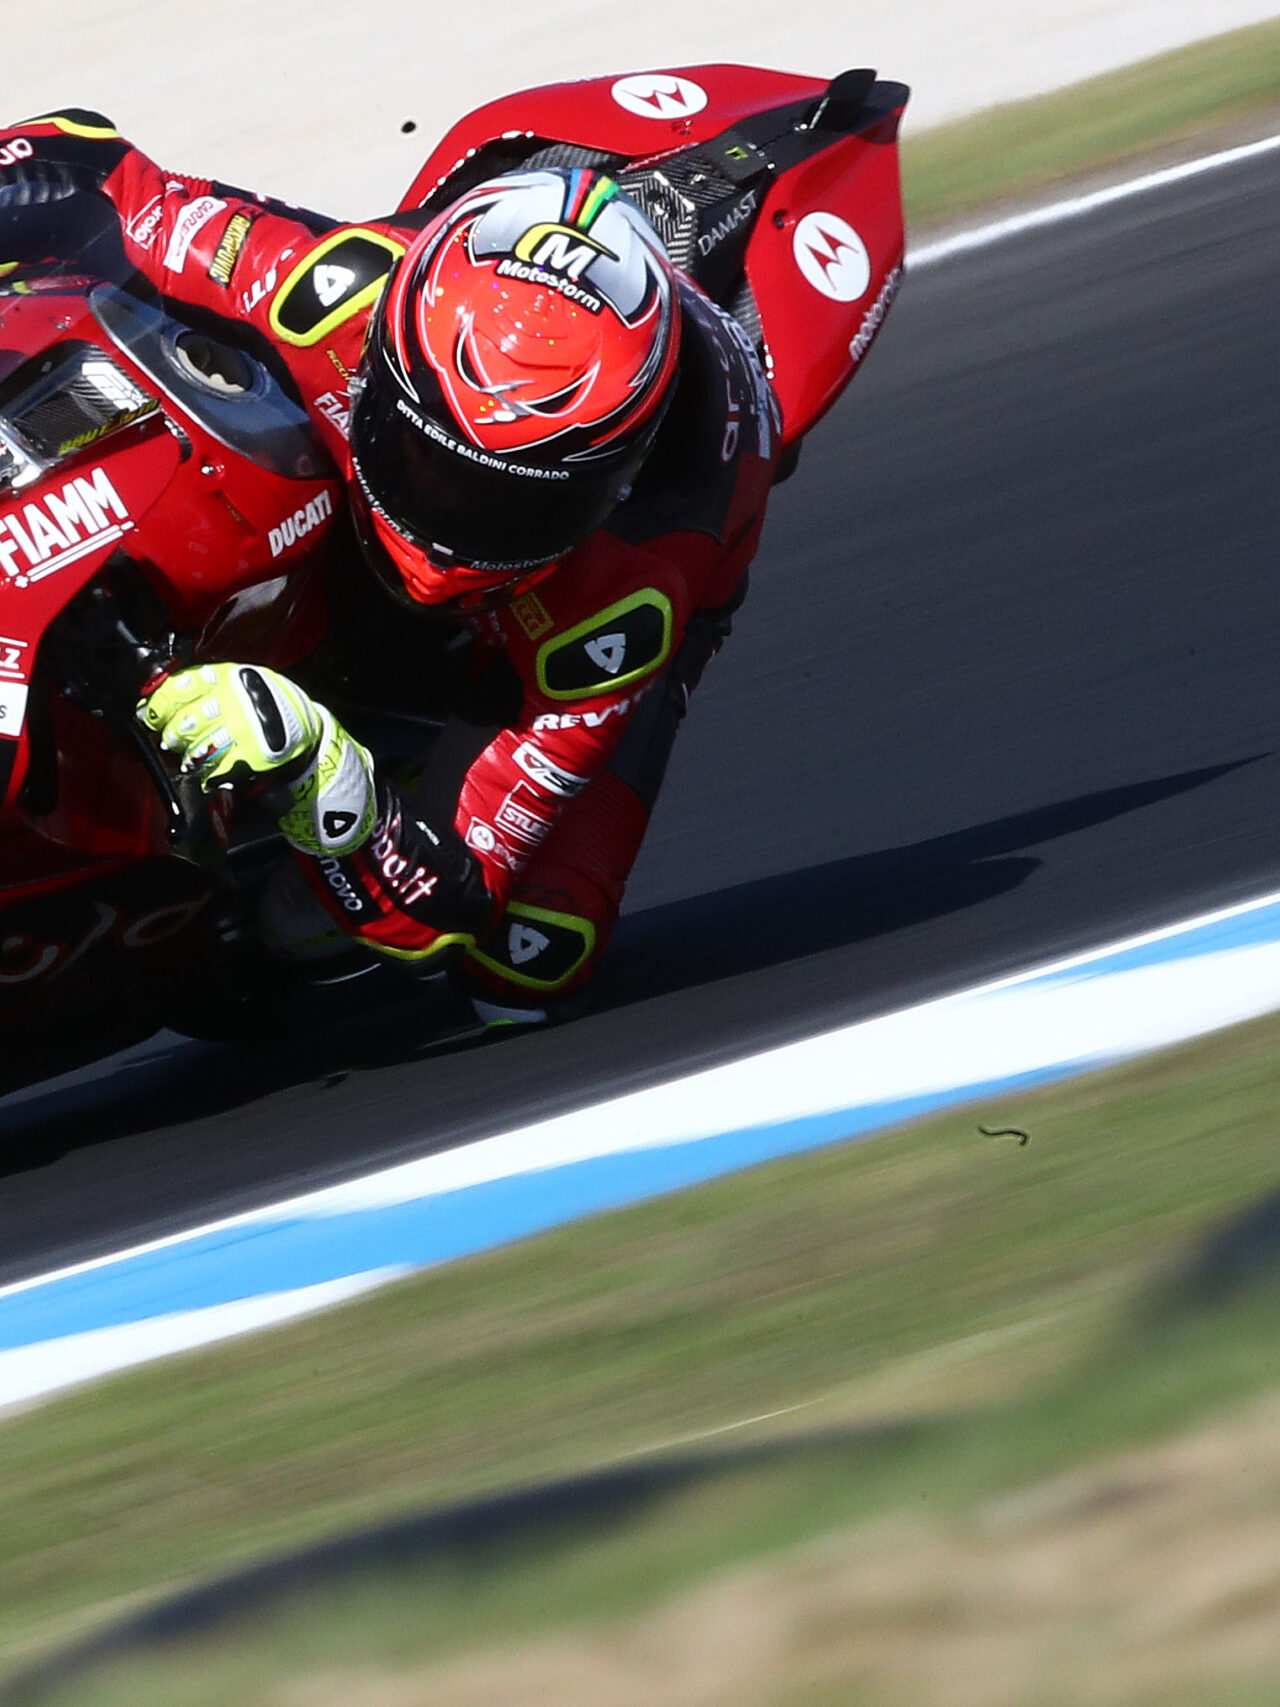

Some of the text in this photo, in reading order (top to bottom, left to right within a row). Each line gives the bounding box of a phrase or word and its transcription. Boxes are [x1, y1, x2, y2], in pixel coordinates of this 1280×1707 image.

[698, 190, 758, 257] DAMAST
[497, 259, 602, 313] Motostorm
[396, 398, 570, 481] DITTA EDILE BALDINI CORRADO
[267, 489, 334, 559] DUCATI
[320, 855, 363, 912] novo
